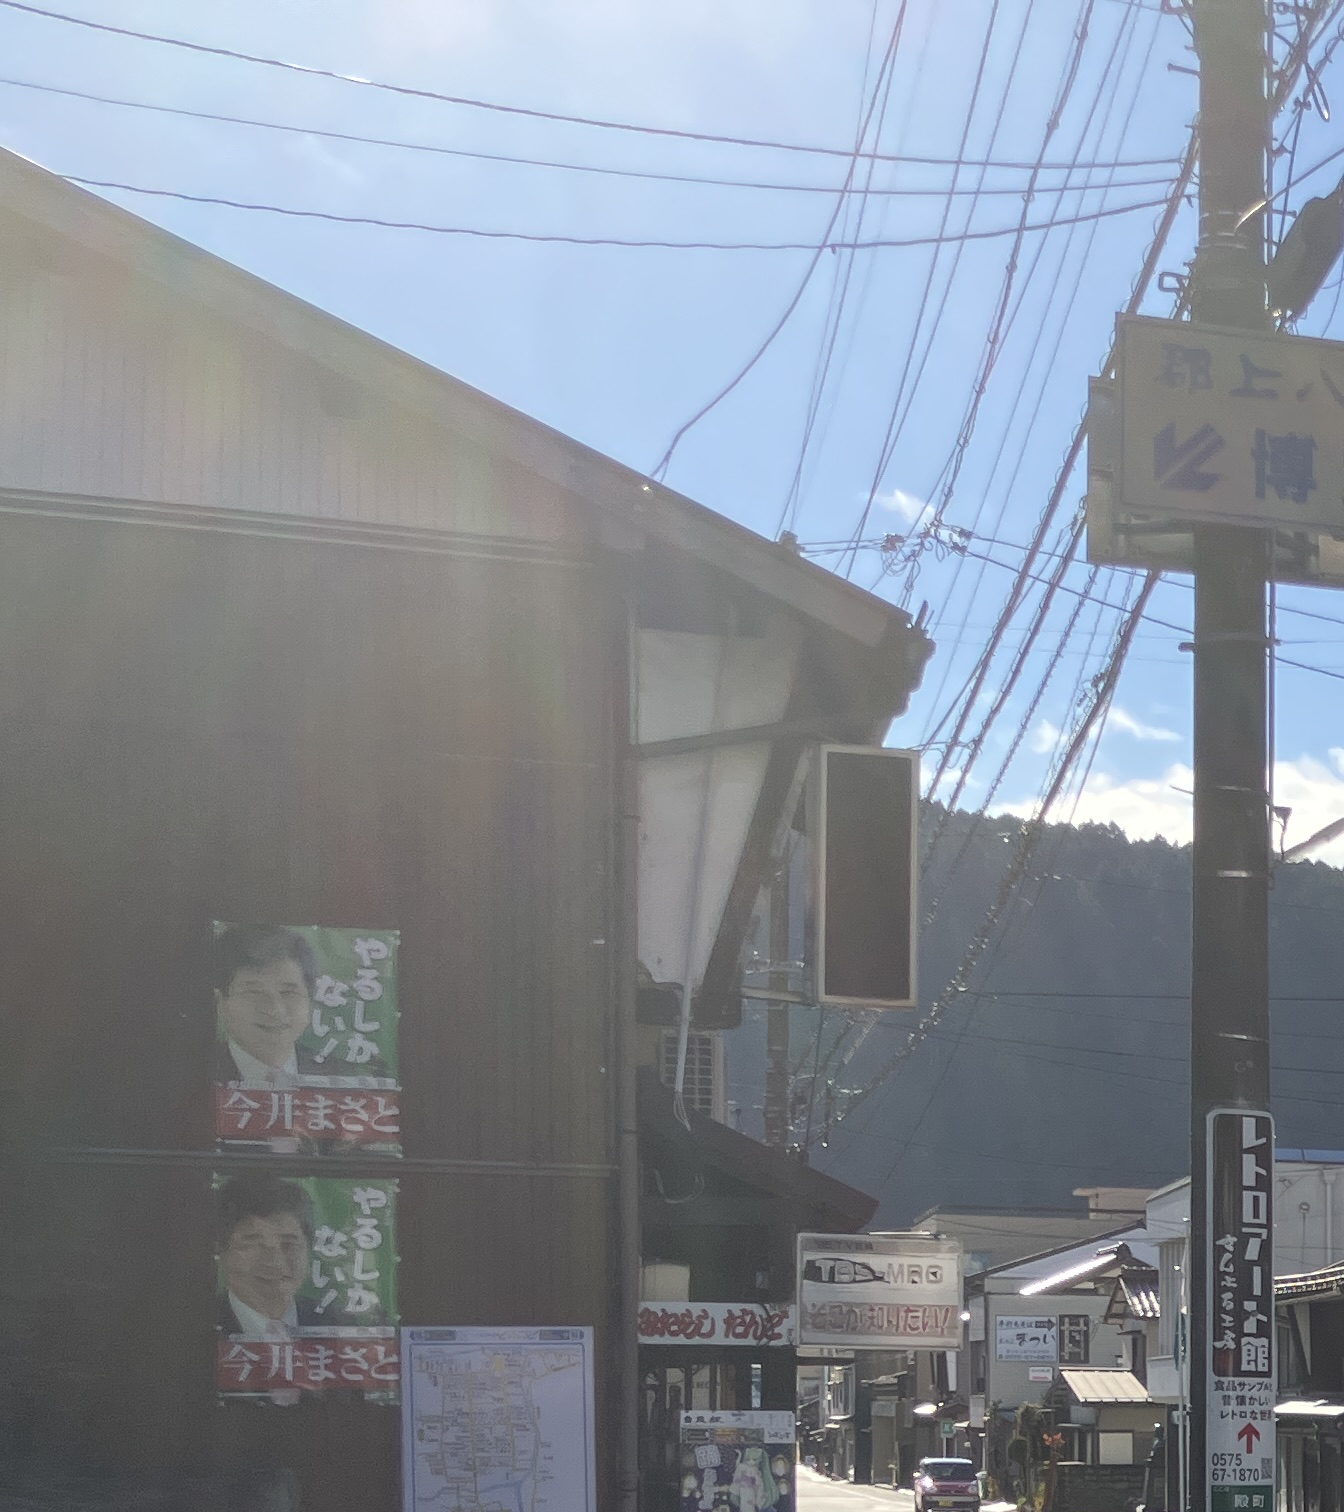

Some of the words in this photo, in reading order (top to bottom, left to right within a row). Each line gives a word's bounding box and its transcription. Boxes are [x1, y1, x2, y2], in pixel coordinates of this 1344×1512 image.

[346, 937, 388, 1064] やるしか
[345, 1186, 388, 1313] やるしか
[1242, 1116, 1270, 1372] レトロアート館
[1211, 1452, 1242, 1466] 0575
[1212, 1468, 1260, 1481] 67-1870
